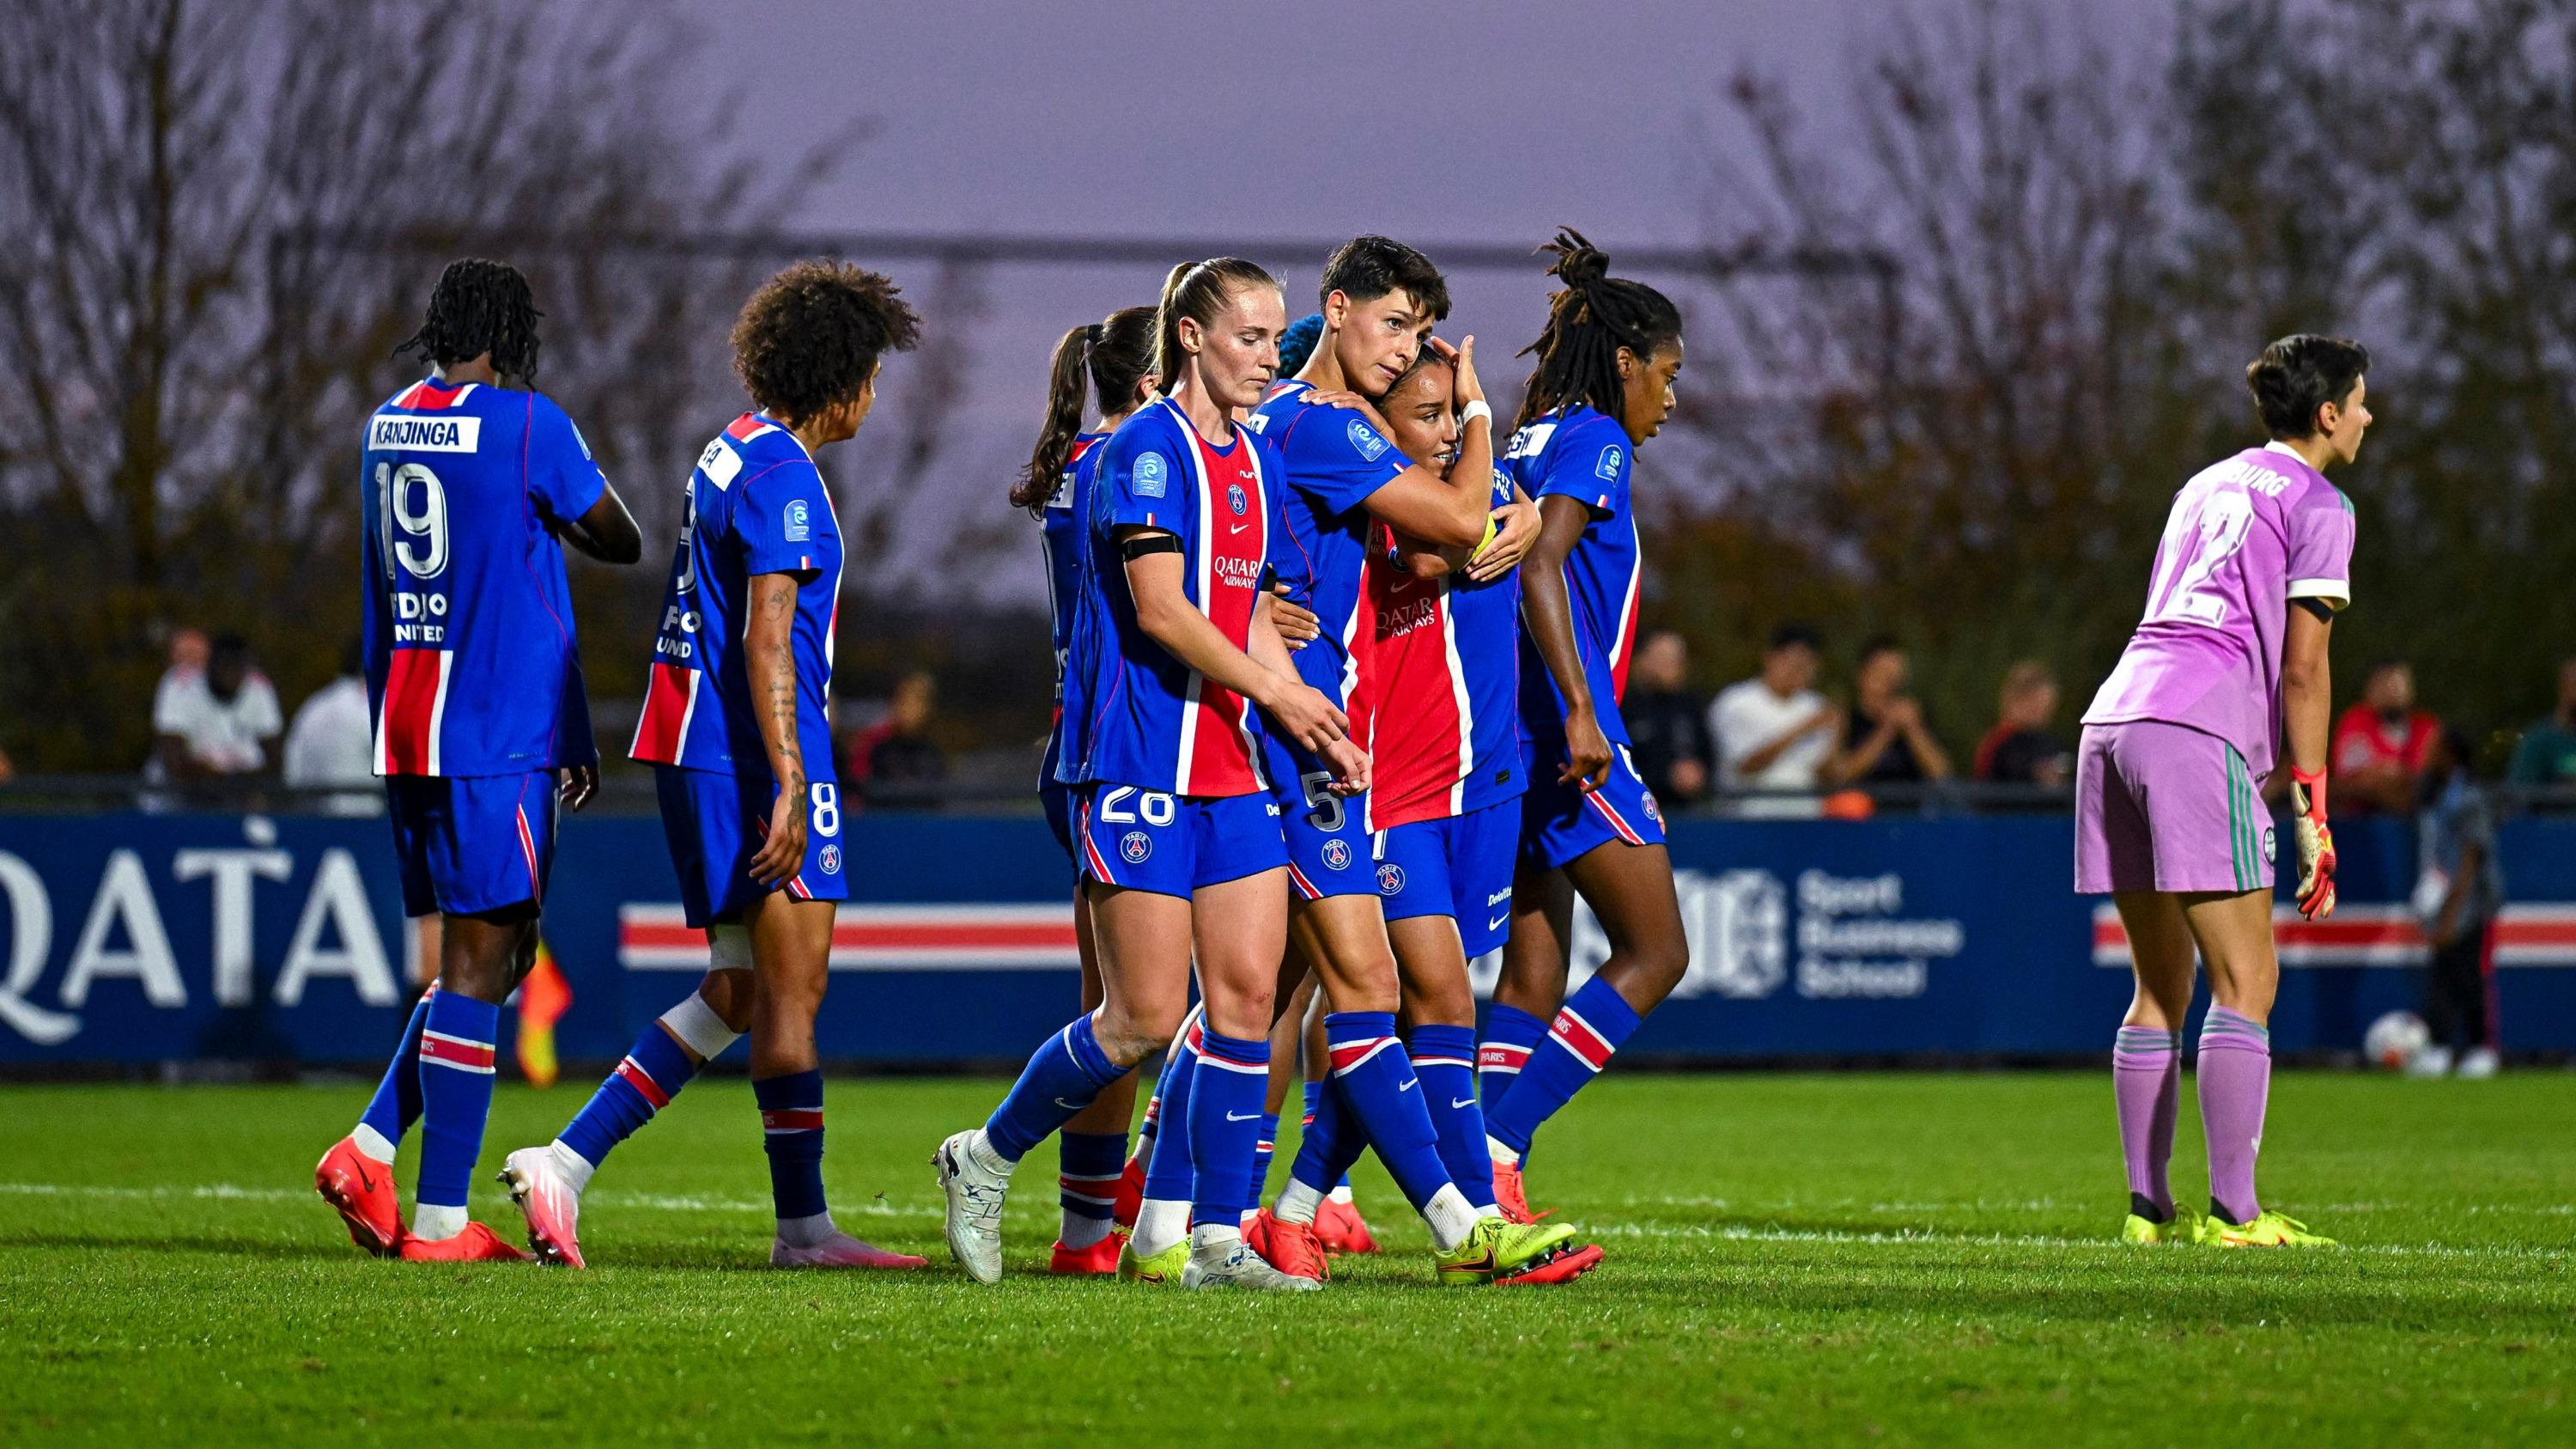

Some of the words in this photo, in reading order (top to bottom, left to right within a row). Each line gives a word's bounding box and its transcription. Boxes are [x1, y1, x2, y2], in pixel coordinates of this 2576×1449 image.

[375, 421, 460, 447] KANJINGA
[2229, 461, 2292, 497] BURG
[375, 462, 449, 581] 19
[1214, 556, 1259, 579] QATAR
[1224, 575, 1256, 590] AIRWAYS
[1376, 597, 1434, 631] QATAR
[395, 624, 444, 642] NITED
[811, 782, 840, 837] 8
[1300, 770, 1346, 832] 5
[1797, 868, 1903, 916] Sport
[0, 814, 438, 1045] ATA
[1795, 960, 1928, 999] School
[1481, 1051, 1505, 1063] PARIS
